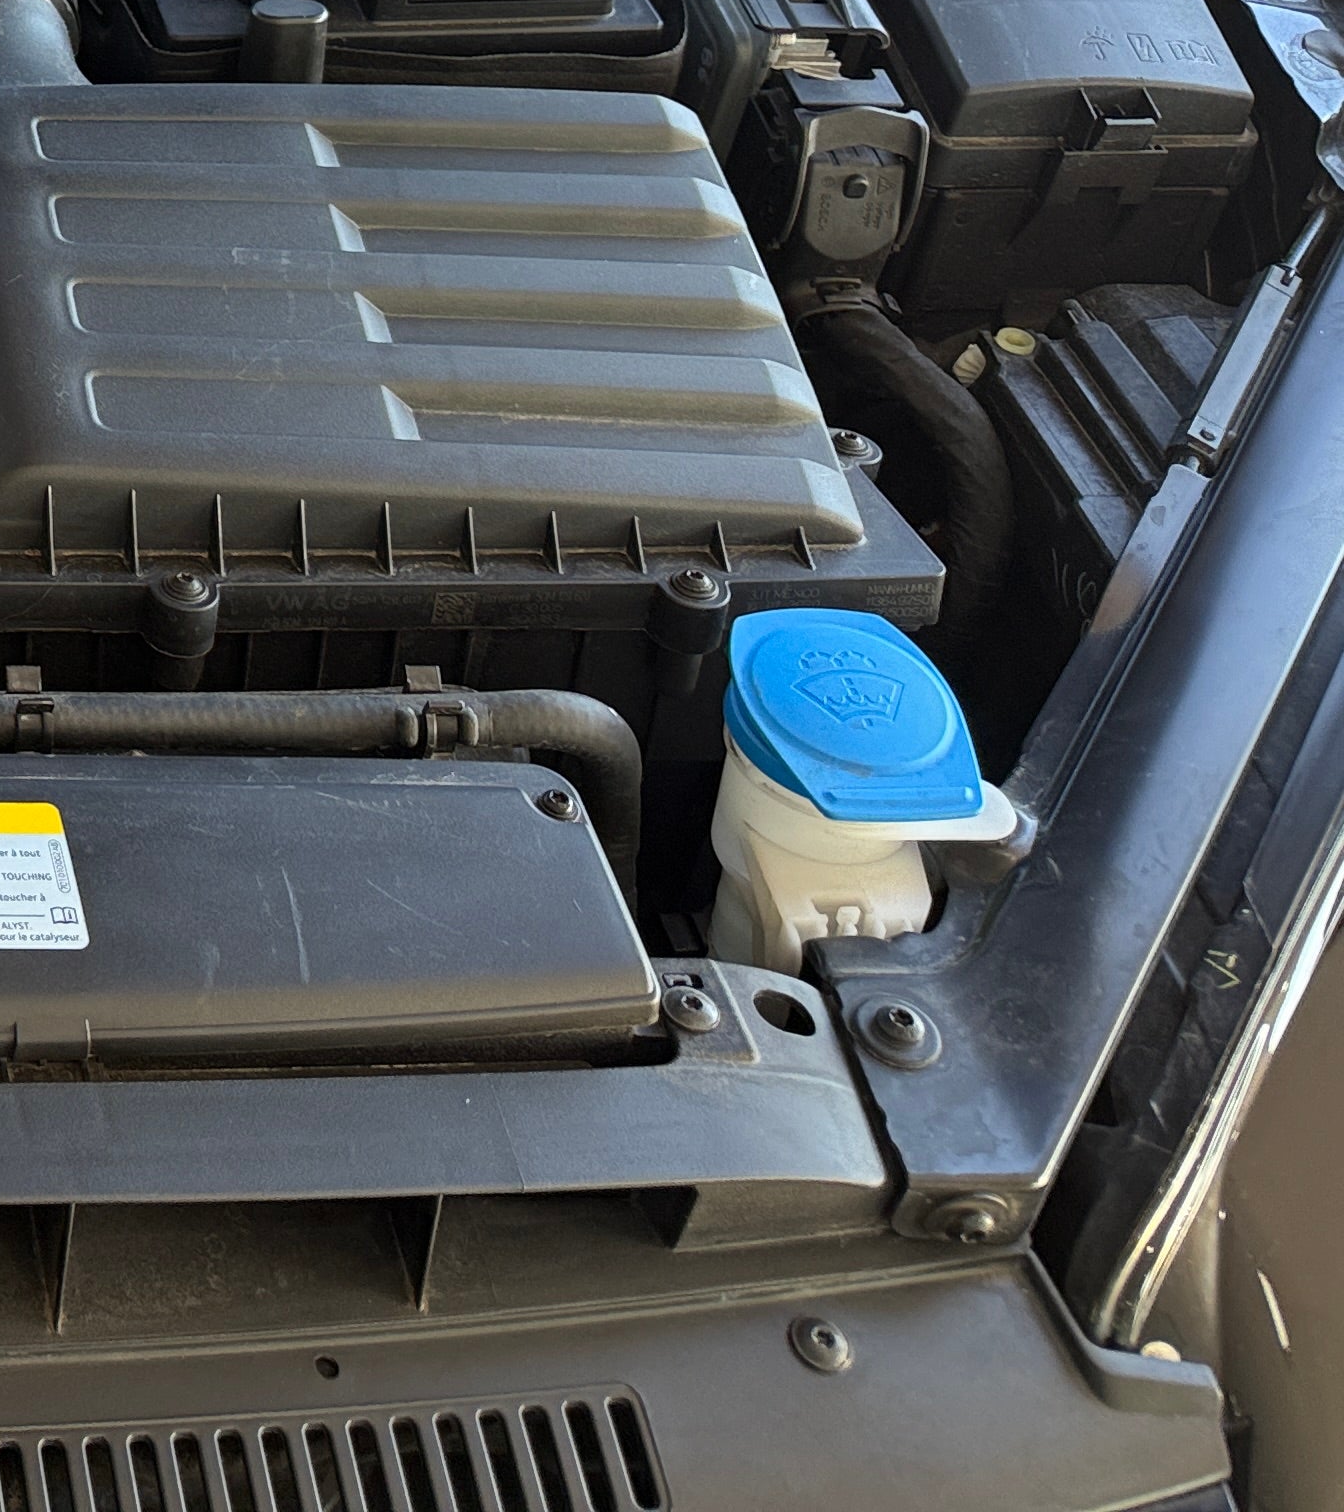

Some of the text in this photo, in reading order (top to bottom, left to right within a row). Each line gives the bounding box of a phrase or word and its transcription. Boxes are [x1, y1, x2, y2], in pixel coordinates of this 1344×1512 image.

[266, 595, 306, 611] VW
[19, 849, 41, 857] tout
[1, 873, 52, 881] TOUCHING
[0, 893, 37, 901] toucher
[39, 893, 46, 901] à
[18, 932, 27, 941] le
